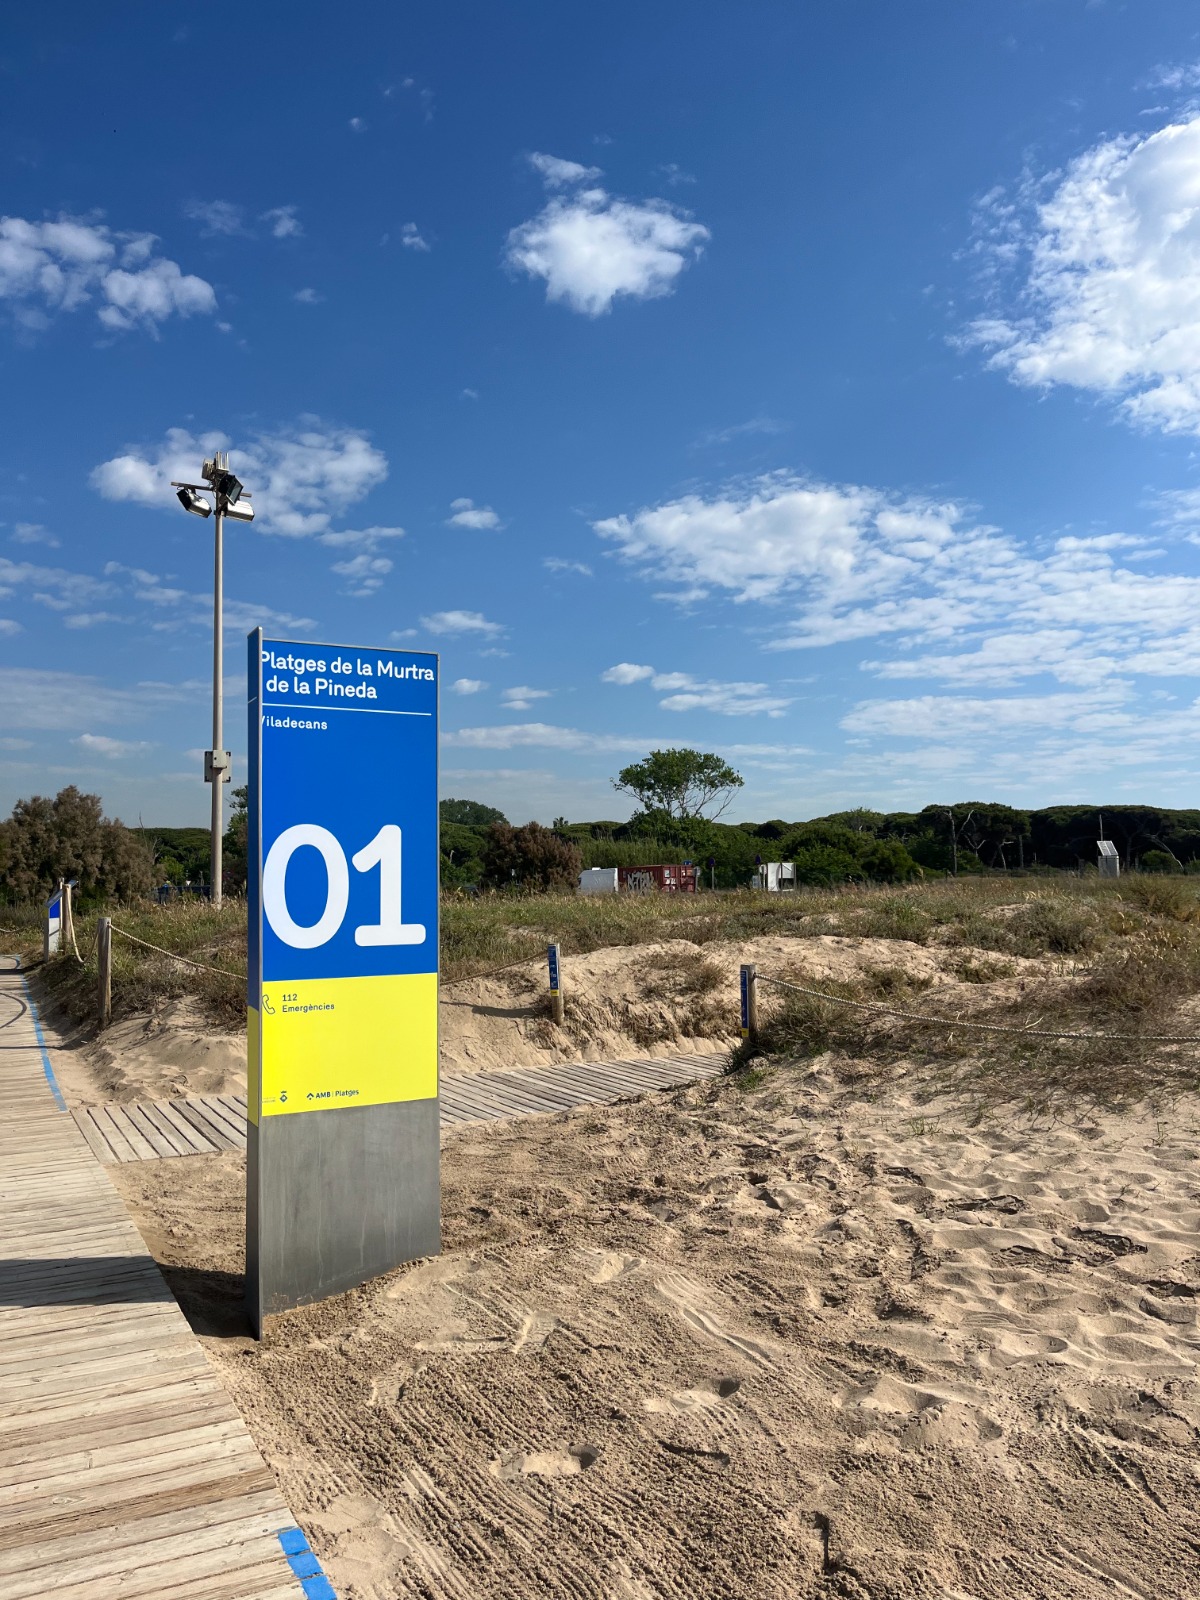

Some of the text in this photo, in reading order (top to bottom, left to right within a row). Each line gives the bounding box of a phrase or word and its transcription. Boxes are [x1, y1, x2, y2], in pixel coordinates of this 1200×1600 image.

[262, 650, 434, 681] Platges de la Murtra
[266, 675, 377, 699] de la Pineda
[262, 823, 427, 949] 01
[282, 993, 298, 1002] 112
[282, 1003, 335, 1014] Emergències
[315, 1089, 359, 1099] AMB Platges
